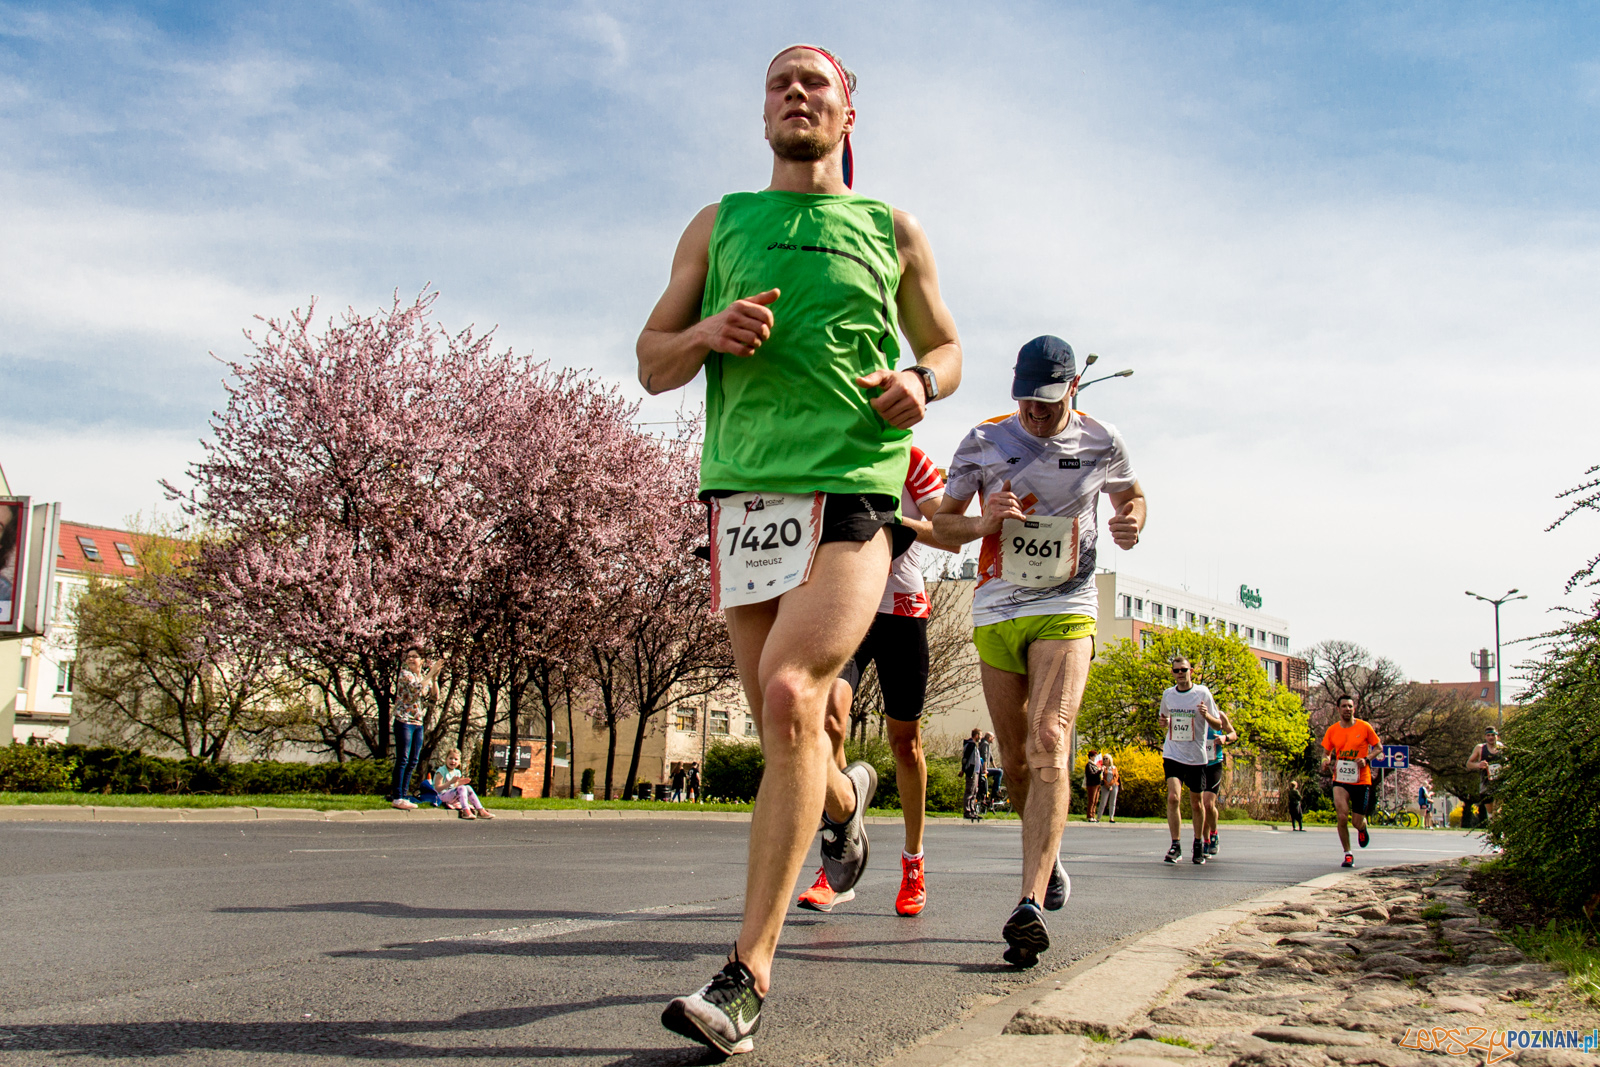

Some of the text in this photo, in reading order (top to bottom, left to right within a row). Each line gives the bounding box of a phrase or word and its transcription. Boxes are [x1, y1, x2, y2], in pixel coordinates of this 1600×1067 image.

[726, 517, 802, 556] 7420
[1012, 536, 1061, 558] 9661
[745, 557, 782, 568] Mateusz
